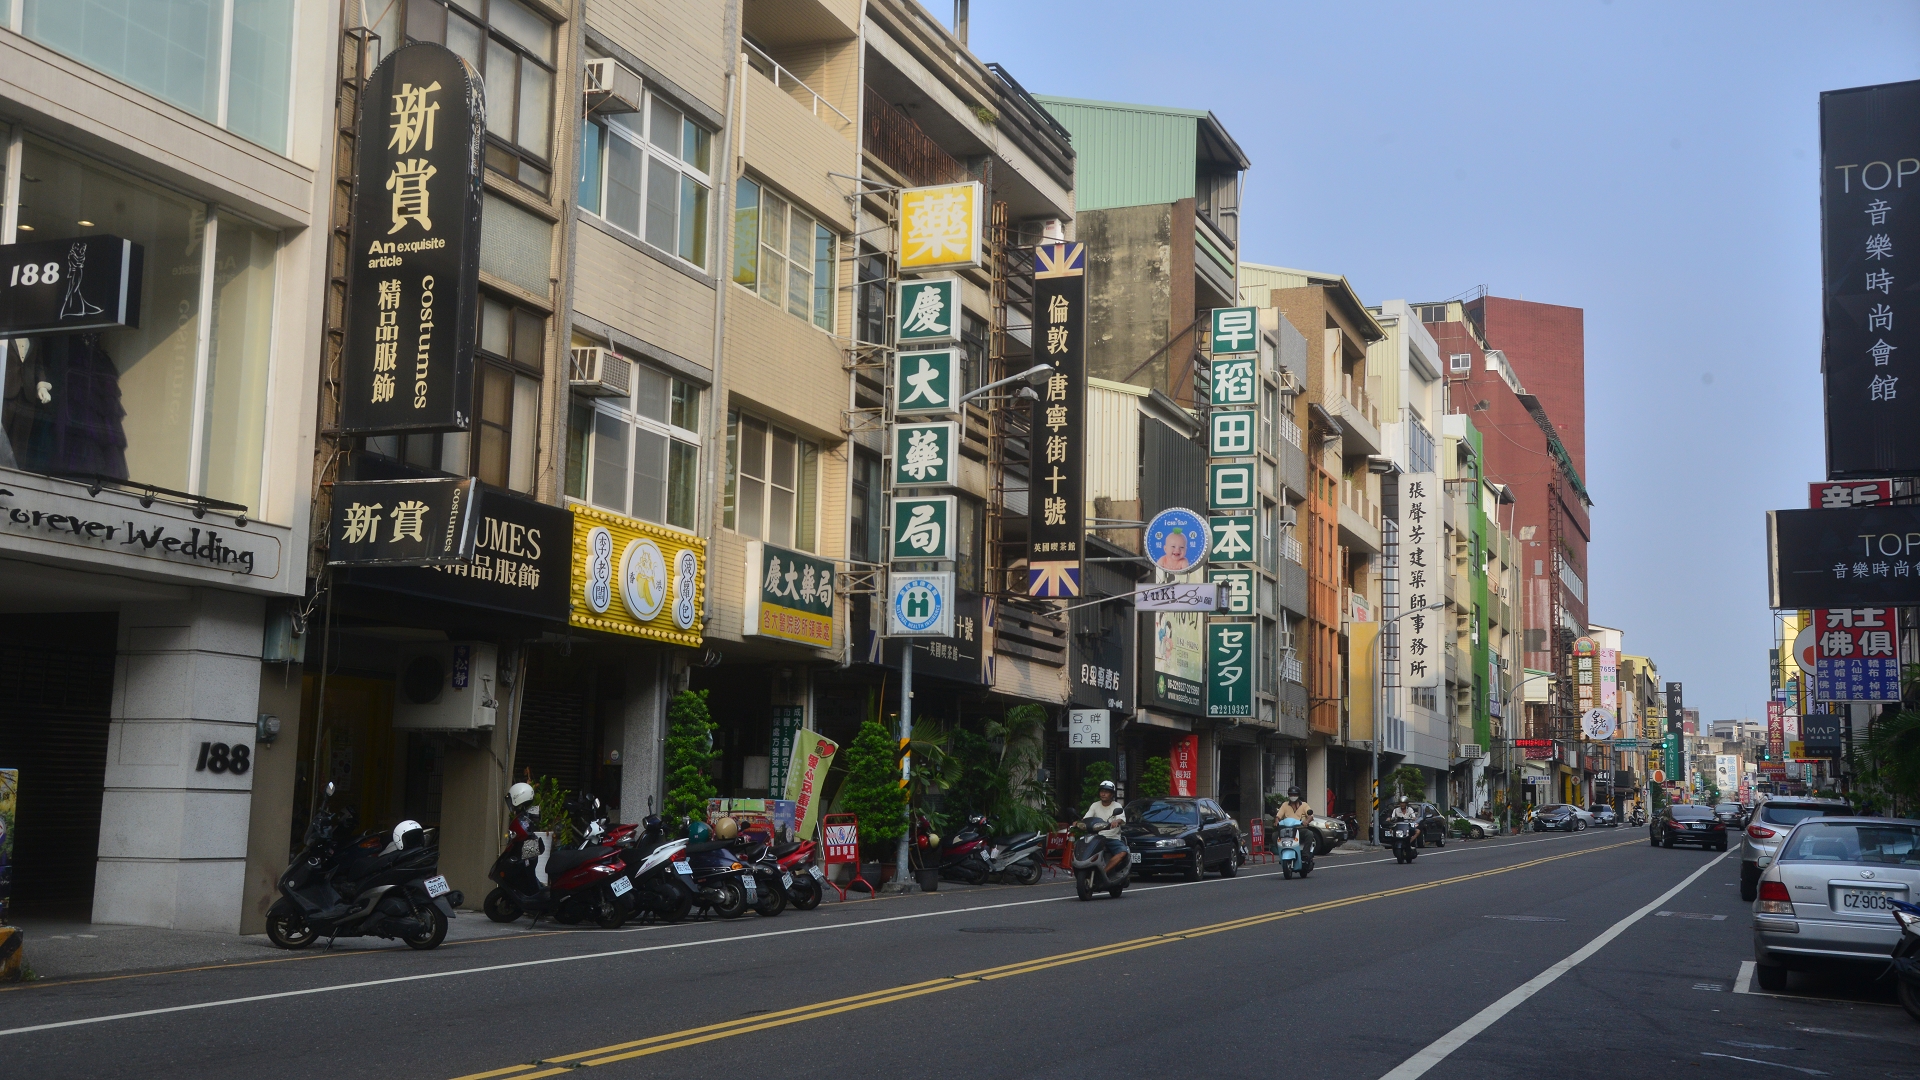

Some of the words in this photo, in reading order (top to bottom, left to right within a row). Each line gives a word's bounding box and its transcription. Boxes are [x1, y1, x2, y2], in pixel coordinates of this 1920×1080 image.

[386, 80, 442, 235] 新賞
[1834, 158, 1920, 194] TOP
[368, 241, 395, 254] An
[397, 237, 446, 254] exquisite
[907, 193, 968, 260] 藥
[10, 262, 60, 288] 188
[368, 255, 402, 269] article
[1864, 198, 1899, 402] 音樂時尚會館
[371, 280, 402, 404] 精品服飾
[414, 274, 436, 410] costumes
[895, 286, 949, 554] 慶大藥局
[341, 500, 430, 544] 新賞
[444, 488, 461, 552] costumes
[121, 519, 254, 575] Wedding
[1034, 542, 1076, 554] 英國喫茶館
[1858, 532, 1920, 557] TOP
[764, 555, 832, 608] 慶大藥局
[1408, 481, 1428, 679] 張聲芳建築師事務所
[953, 614, 974, 641] 十號
[1819, 630, 1893, 657] 佛俱
[1217, 628, 1244, 702] センター
[1219, 705, 1249, 715] 2219327
[1806, 726, 1836, 734] MAP
[196, 741, 250, 775] 188
